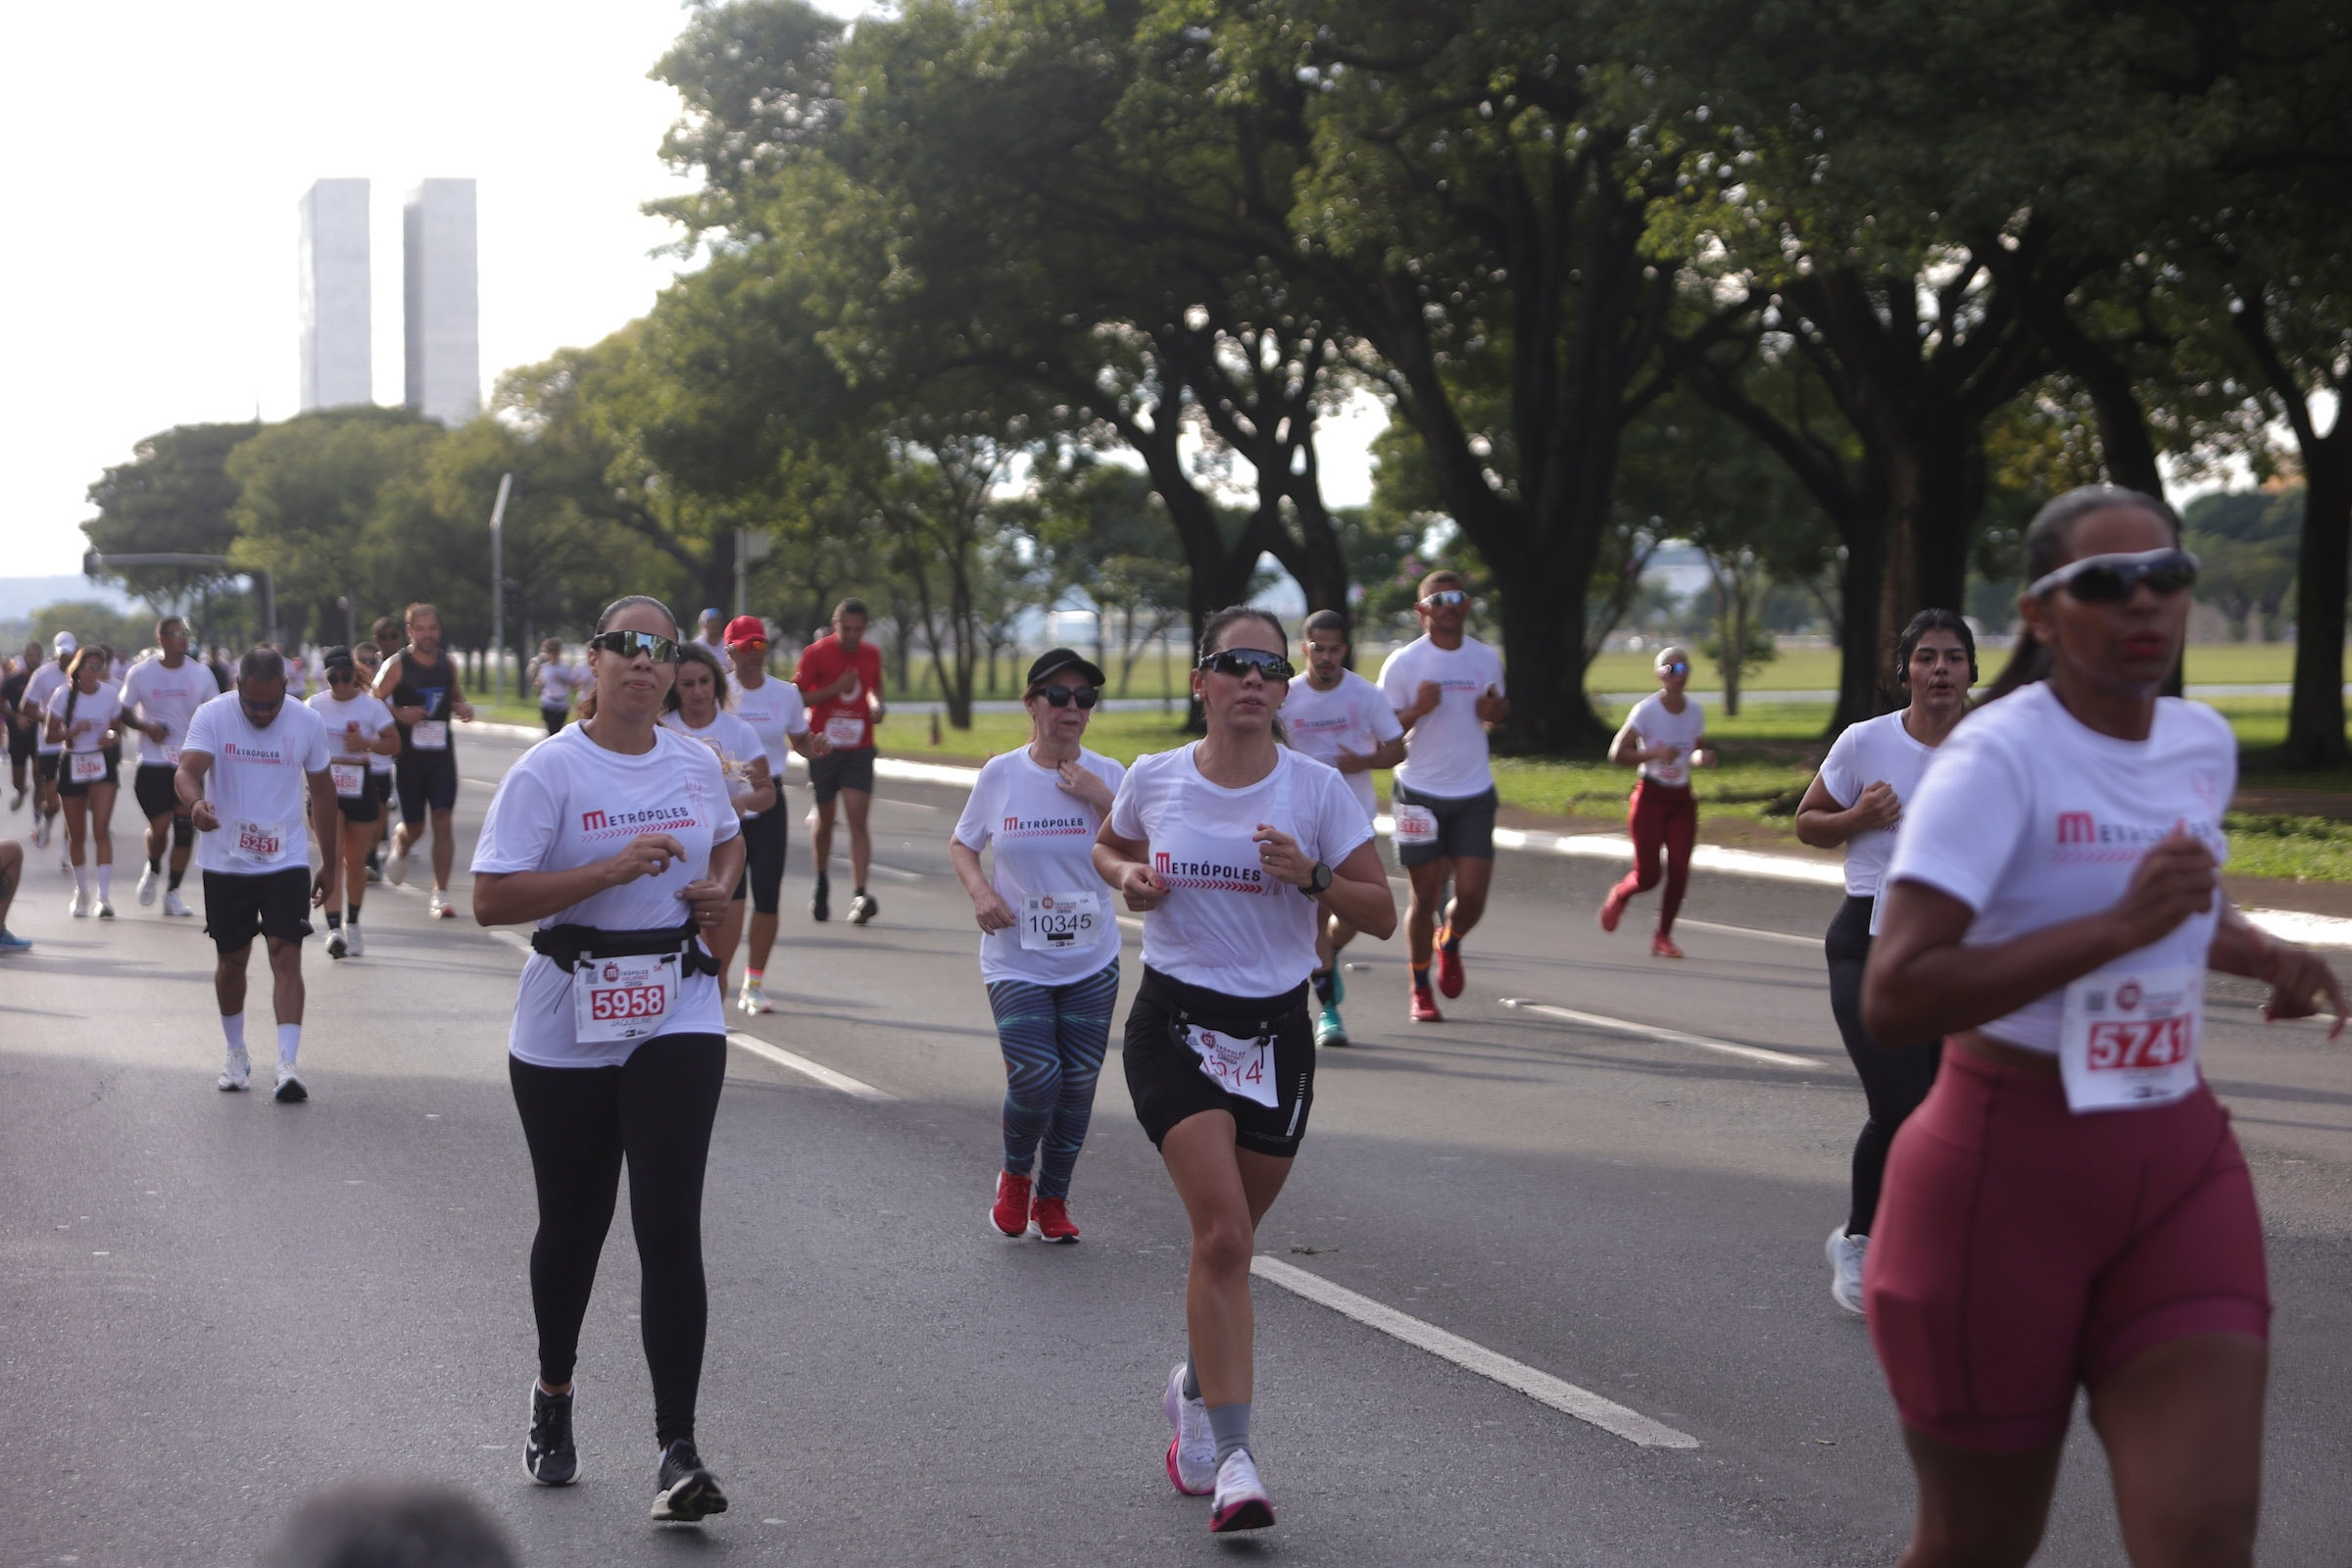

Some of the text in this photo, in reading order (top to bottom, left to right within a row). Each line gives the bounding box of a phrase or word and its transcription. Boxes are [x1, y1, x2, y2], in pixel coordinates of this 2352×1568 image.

[225, 743, 280, 758] METRÓPOLES
[581, 807, 689, 831] METRÓPOLES
[1004, 816, 1084, 831] METRÓPOLES
[241, 834, 276, 852] 5251
[1156, 852, 1261, 882] METRÓPOLES
[1029, 912, 1092, 934] 10345
[594, 987, 663, 1018] 5958
[2090, 1020, 2188, 1068] 5741
